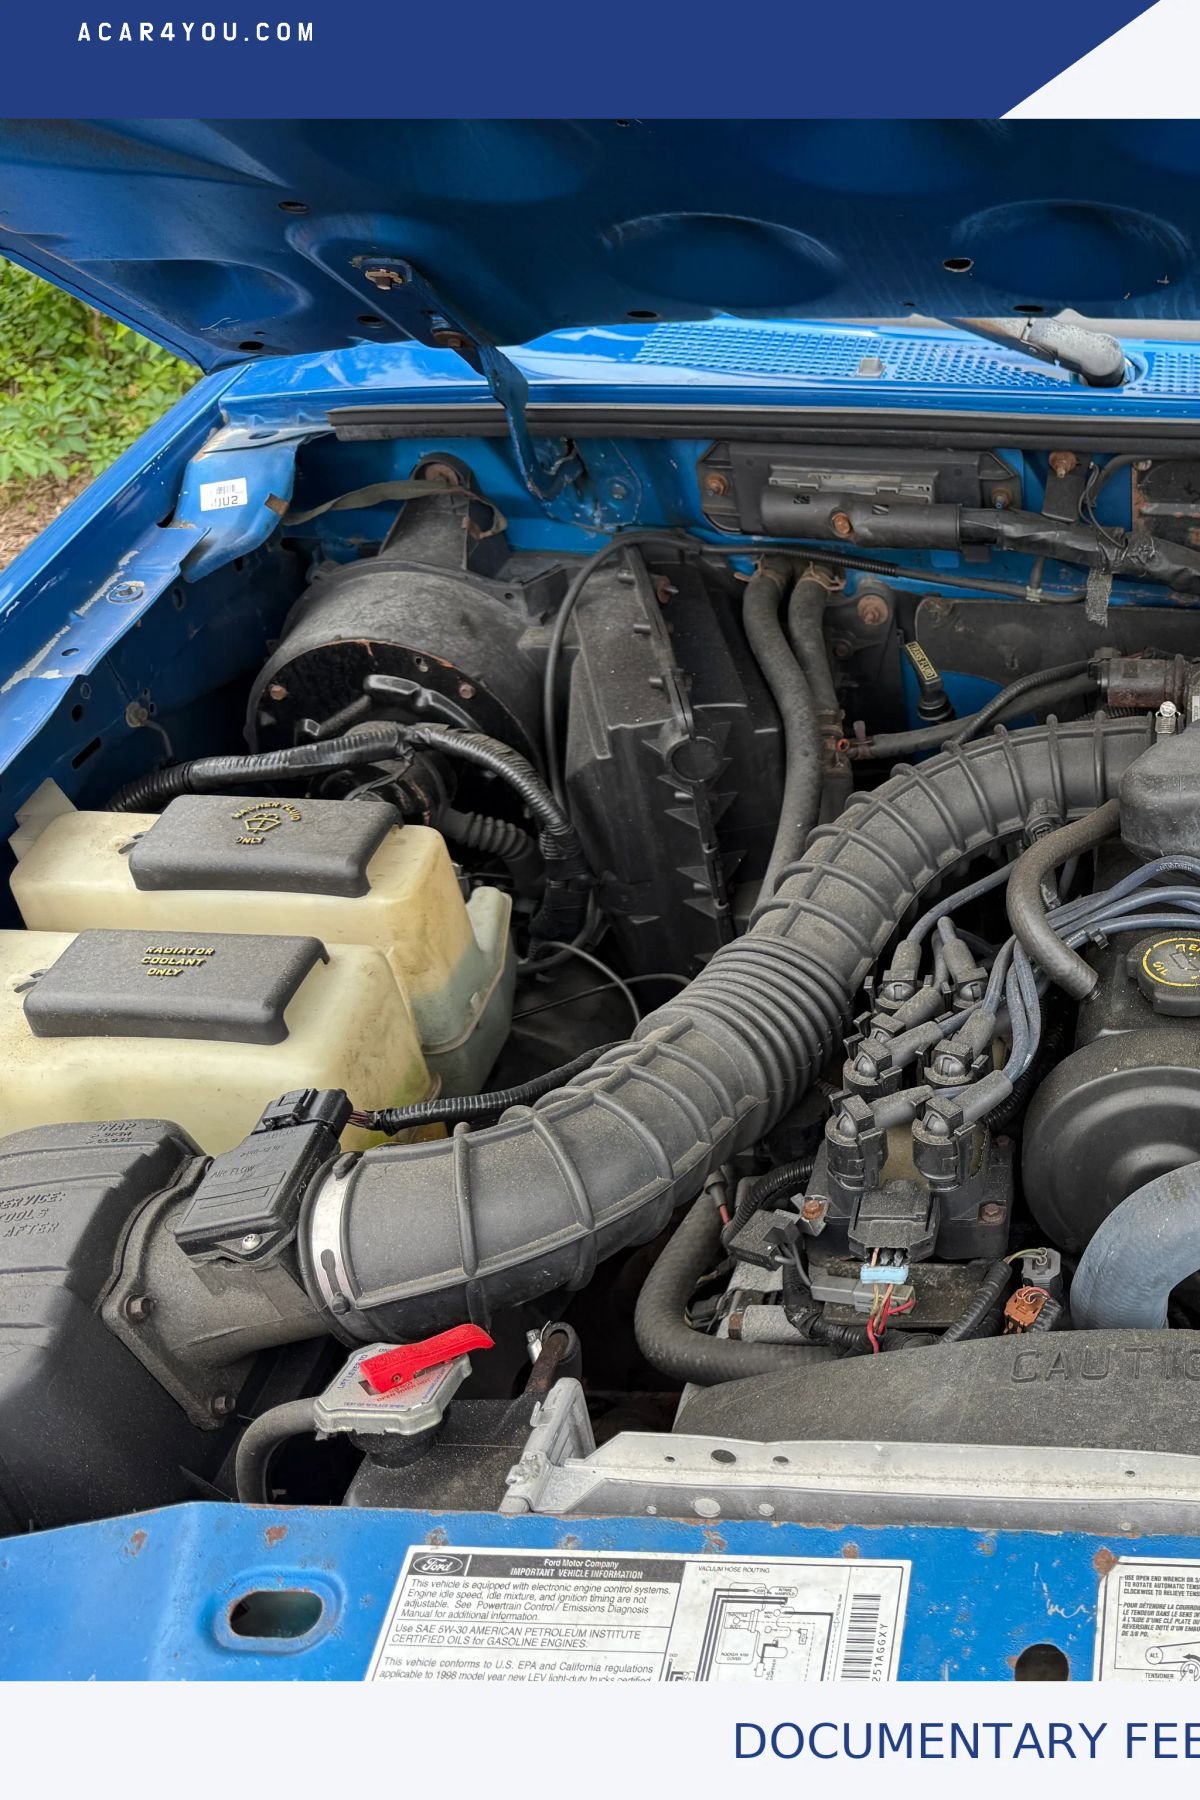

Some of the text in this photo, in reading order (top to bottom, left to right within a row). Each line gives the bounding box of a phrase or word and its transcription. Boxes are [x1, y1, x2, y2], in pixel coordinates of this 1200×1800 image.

[146, 947, 216, 955] RADIATOR
[141, 957, 206, 966] COOLANT
[147, 968, 184, 976] ONLY
[1153, 961, 1168, 976] OIL
[421, 1558, 453, 1571] Ford
[562, 1559, 583, 1567] Motor
[585, 1560, 619, 1569] Company
[510, 1567, 643, 1579] IMPORTANT VEHICLE INFORMATION
[411, 1579, 671, 1595] This vehicle is equipped with electronic engine control systems.
[395, 1624, 642, 1640] Use SAE 5W-30 AMERICAN PETROLEUM INSTITUTE
[392, 1634, 588, 1648] CERTIFIED OILS for GASOLINE ENGINES.
[384, 1657, 653, 1674] This vehicle conforms to U.S. EPA and California regulations
